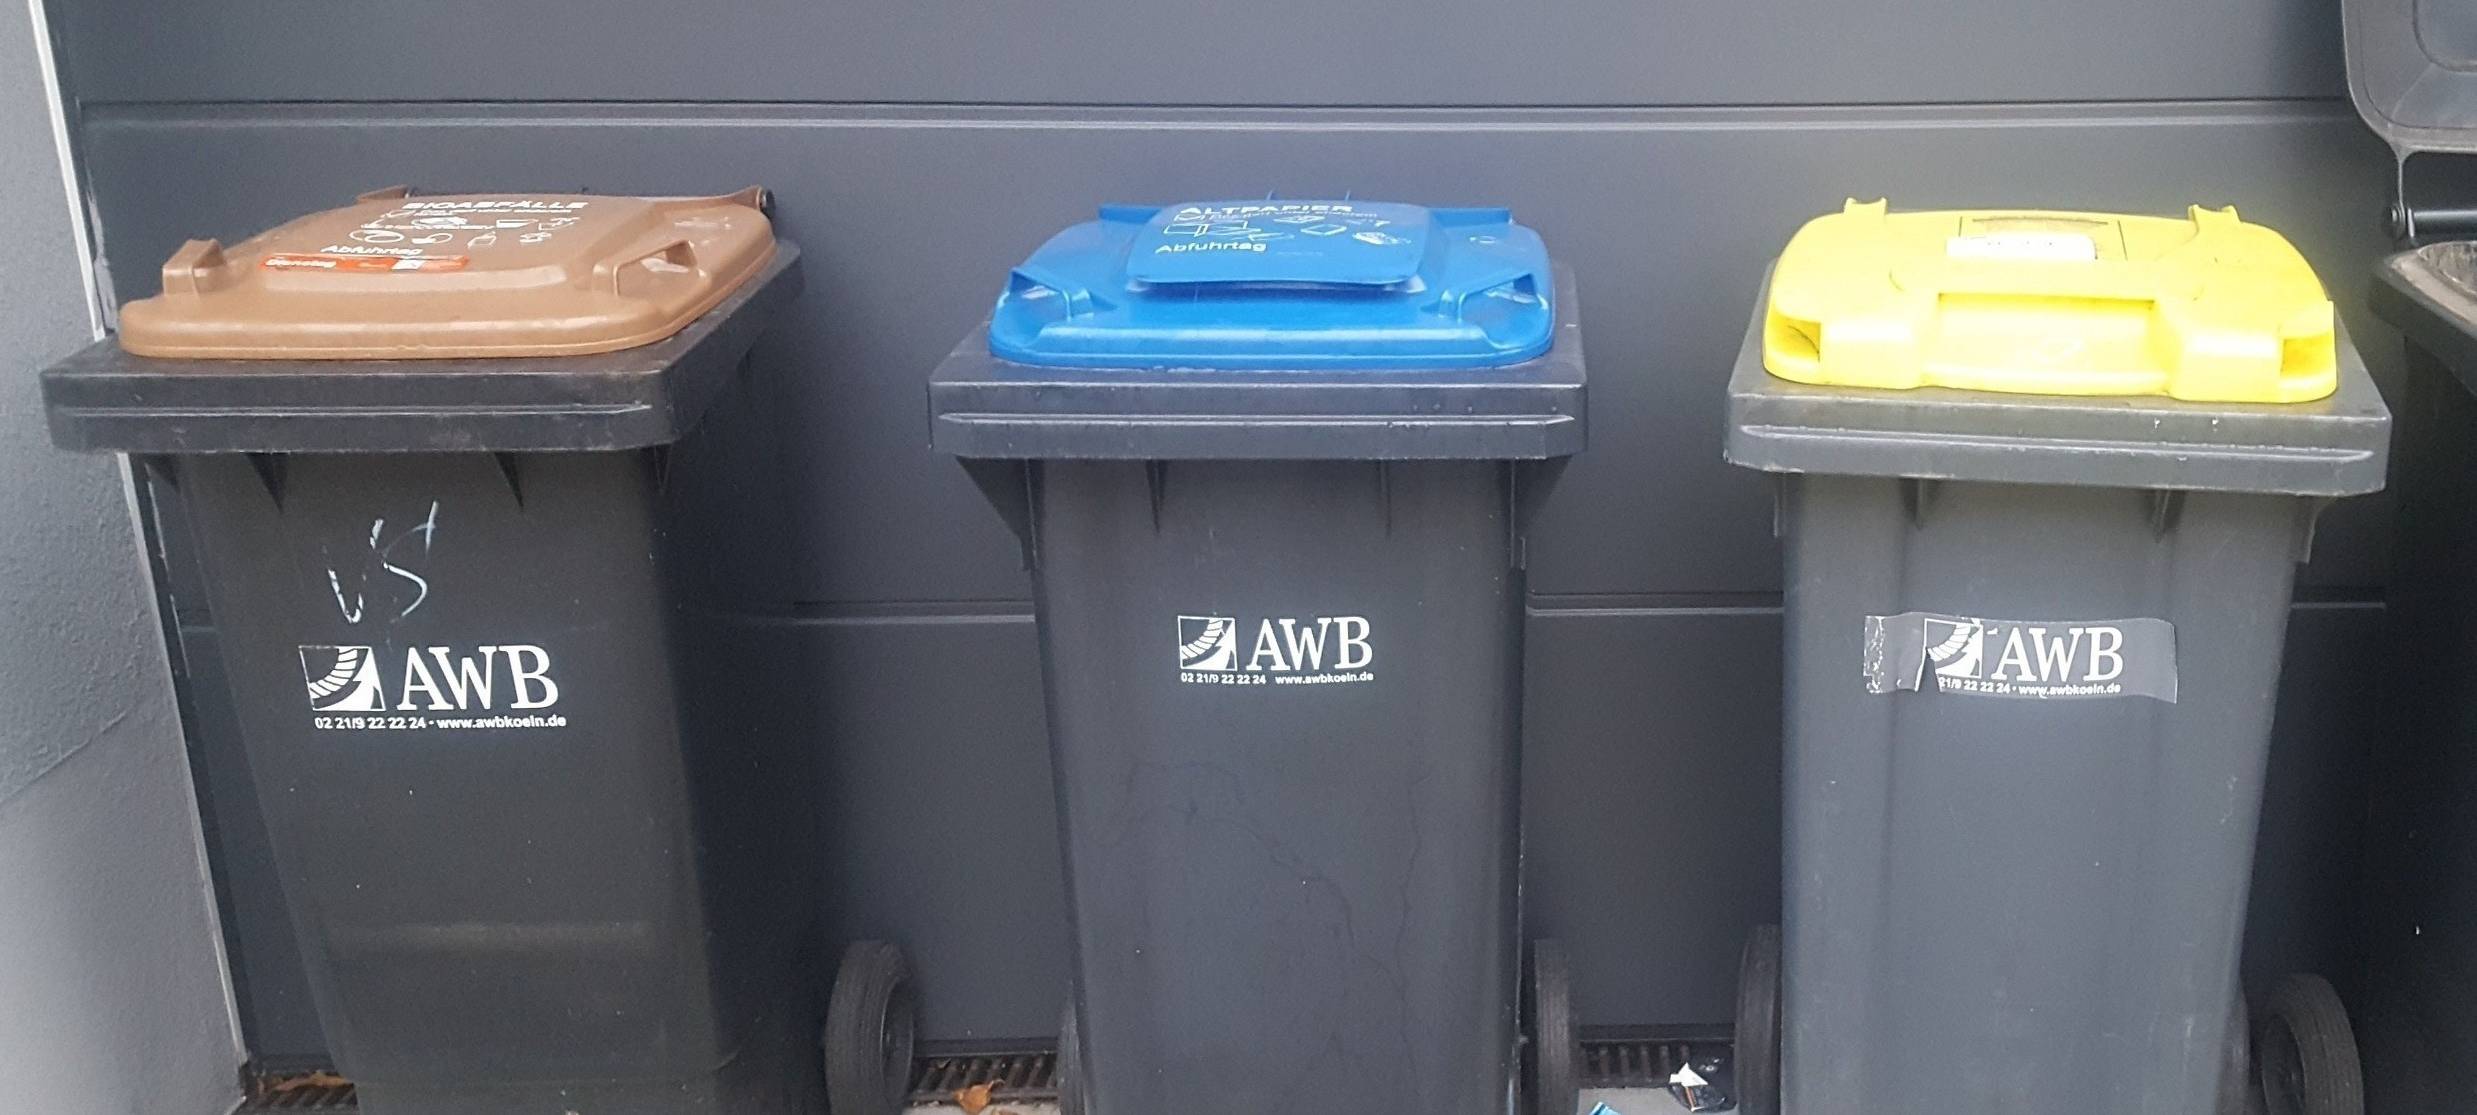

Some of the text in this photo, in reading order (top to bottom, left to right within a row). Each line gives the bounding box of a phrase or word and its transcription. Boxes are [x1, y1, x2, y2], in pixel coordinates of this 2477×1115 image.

[1180, 205, 1353, 214] ALTPAPIER
[1156, 241, 1267, 253] Abfuhrtag
[1246, 617, 1372, 671] AWB
[1990, 627, 2123, 682] AWB
[397, 645, 558, 710] AWB
[1181, 672, 1194, 683] 02
[1221, 674, 1235, 684] 22
[1237, 674, 1250, 685] 22
[1253, 674, 1266, 685] 24
[1275, 672, 1374, 685] www.awbkoeln.de
[1964, 680, 1978, 691] 22
[1980, 682, 1994, 693] 22
[1996, 683, 2011, 694] 24
[2018, 683, 2121, 697] www.awbkoeln.de
[315, 717, 333, 730] 02
[367, 717, 386, 730] 22
[387, 717, 407, 730] 22
[408, 717, 427, 730] 24
[436, 714, 566, 729] www.awbkoeln.de
